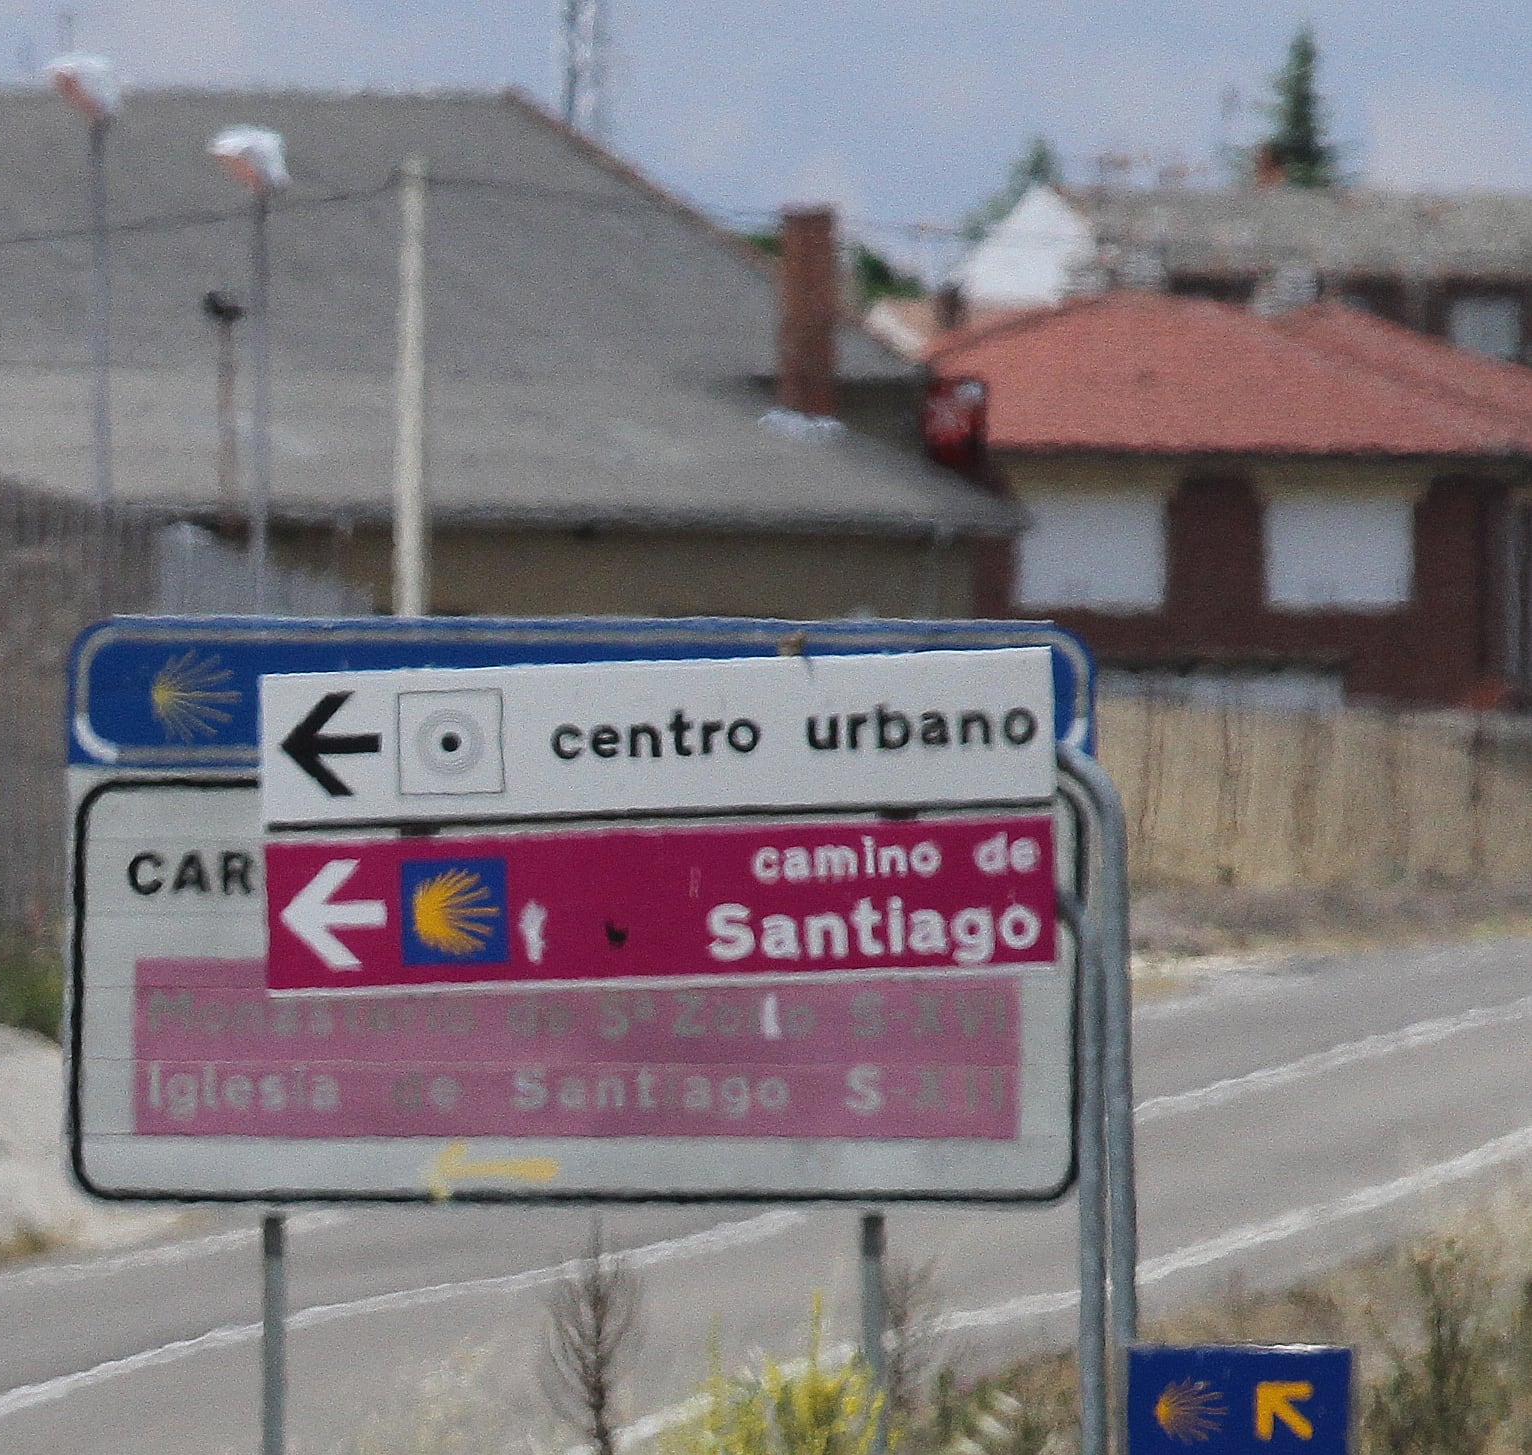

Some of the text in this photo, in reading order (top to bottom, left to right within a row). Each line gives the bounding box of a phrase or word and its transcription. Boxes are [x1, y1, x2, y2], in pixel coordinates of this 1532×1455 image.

[550, 703, 1039, 762] centro urbano
[752, 832, 1041, 882] camino de
[707, 896, 1042, 969] Santiago
[147, 1063, 342, 1122] Iglesia
[389, 1072, 463, 1114] de
[510, 1065, 791, 1120] Santiago
